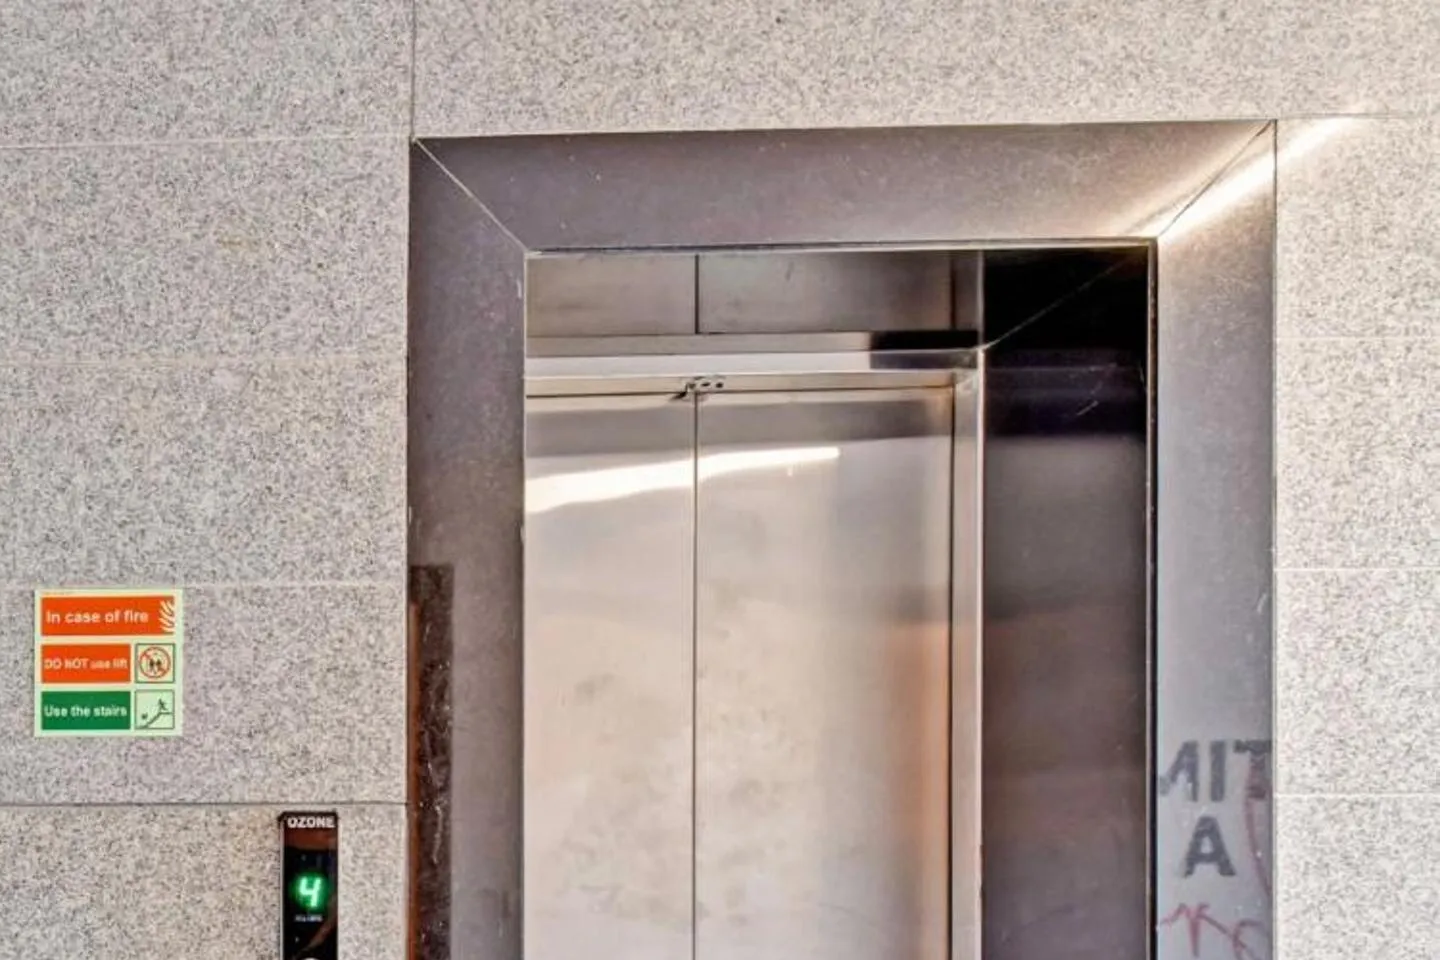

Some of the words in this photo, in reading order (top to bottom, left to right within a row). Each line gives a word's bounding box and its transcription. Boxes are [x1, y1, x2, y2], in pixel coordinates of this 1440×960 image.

[46, 610, 60, 624] In
[65, 613, 100, 624] case
[105, 610, 120, 624] of
[124, 609, 149, 623] fire
[44, 658, 62, 670] DO
[64, 658, 90, 670] NOT
[90, 660, 110, 670] use
[113, 657, 128, 669] lift
[44, 705, 68, 717] Use
[70, 704, 91, 717] the
[93, 704, 128, 717] stairs
[287, 816, 336, 829] OZONE
[298, 876, 323, 909] 4
